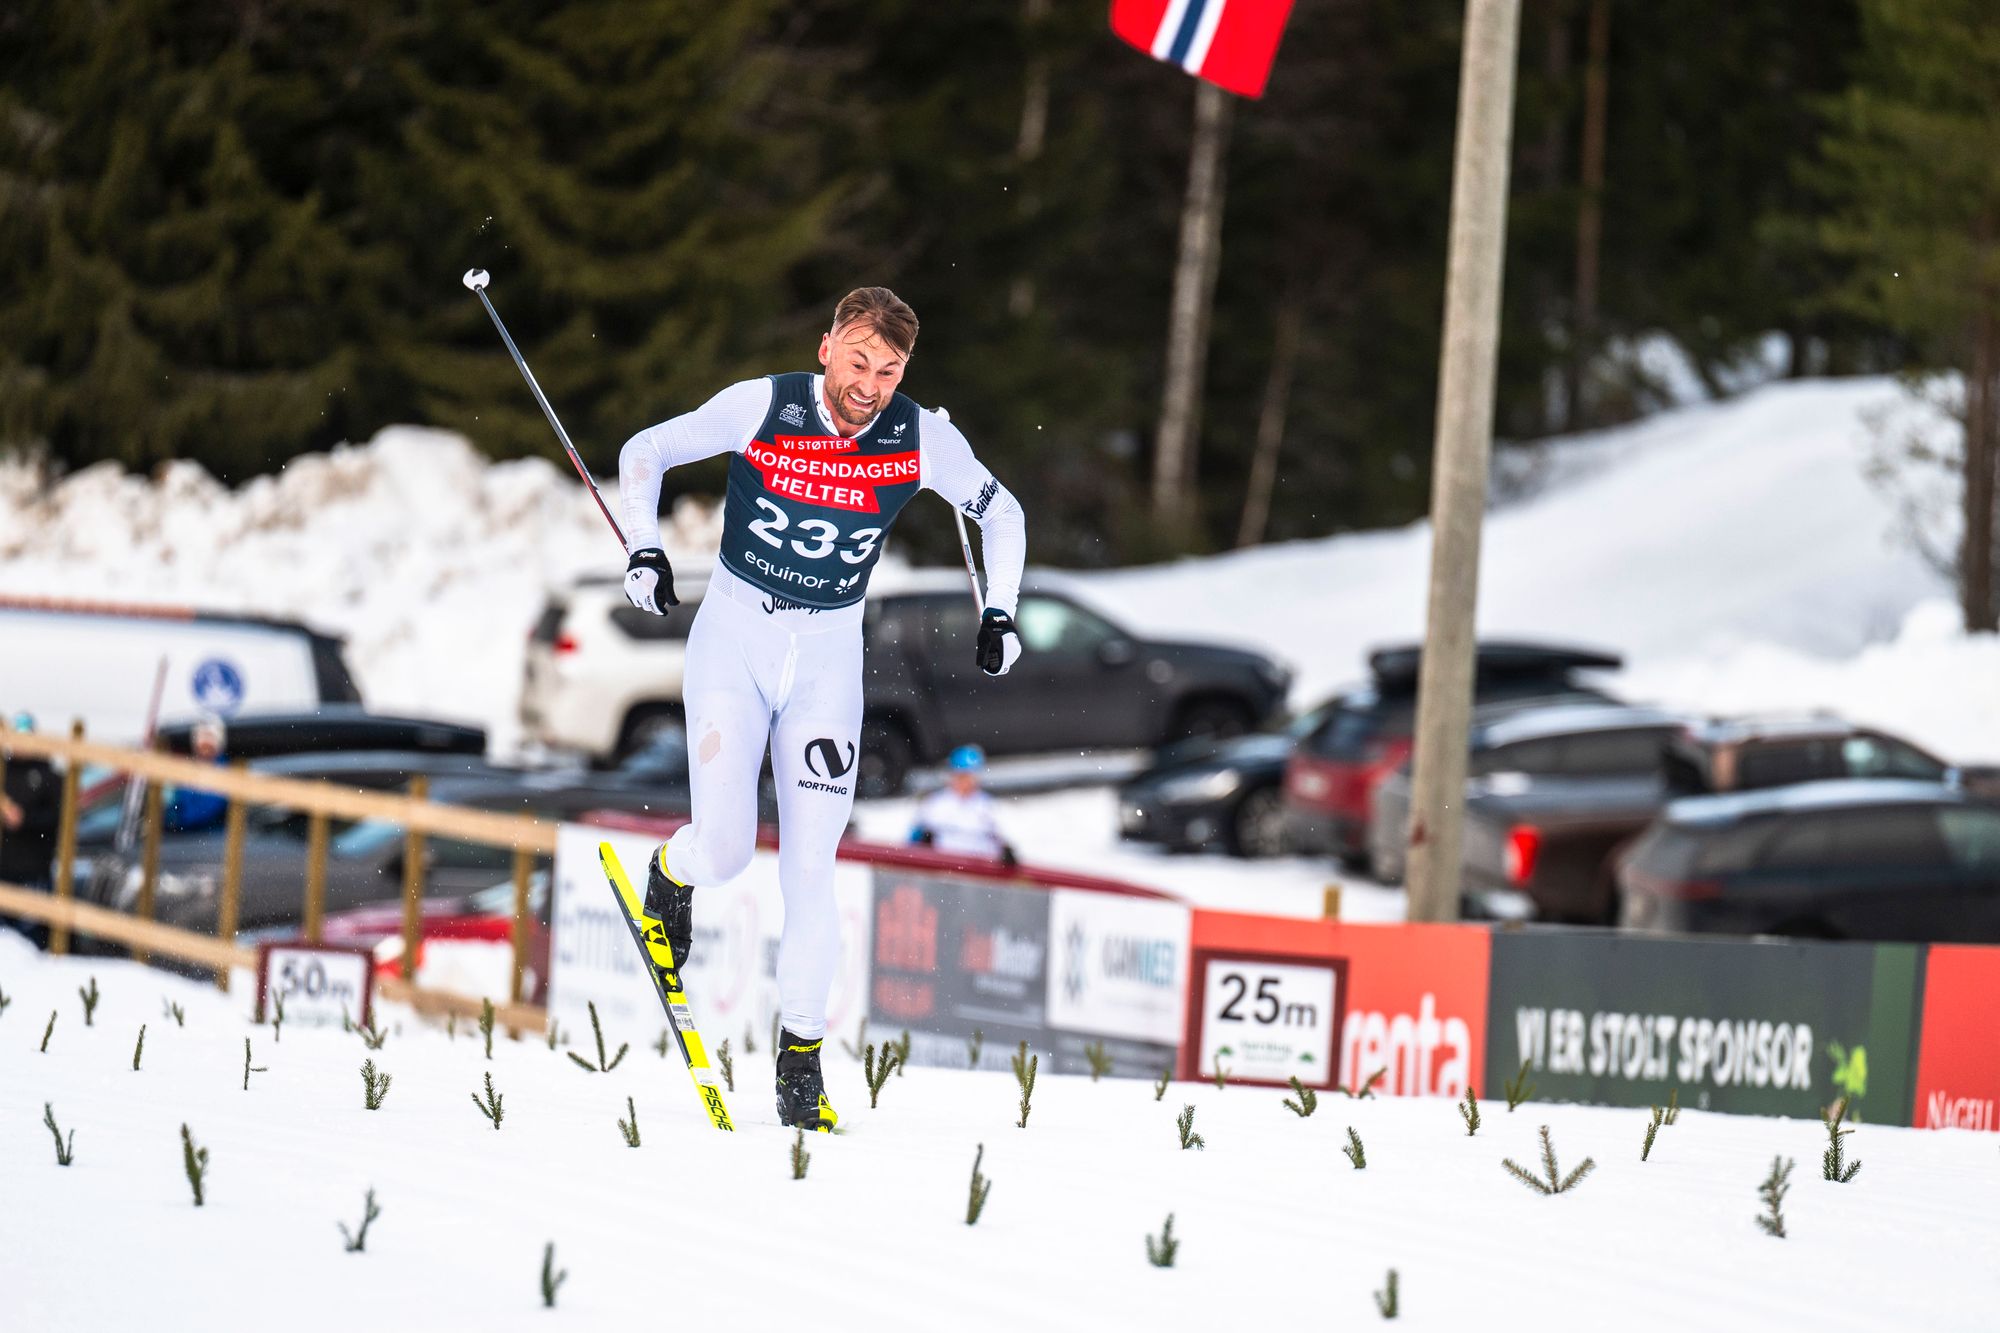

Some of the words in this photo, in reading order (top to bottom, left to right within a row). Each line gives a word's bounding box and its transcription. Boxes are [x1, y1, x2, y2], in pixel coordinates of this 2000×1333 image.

[747, 445, 918, 479] MORGENDAGENS
[782, 440, 795, 450] VI
[797, 439, 851, 451] STØTTER
[771, 473, 865, 507] HELTER
[747, 496, 882, 565] 233
[744, 550, 830, 589] equinor
[798, 779, 848, 795] NORTHUG
[1516, 1006, 1546, 1072] VI
[1549, 1008, 1585, 1075] ER
[1590, 1011, 1677, 1082] STOLT
[1677, 1016, 1813, 1090] SPONSOR
